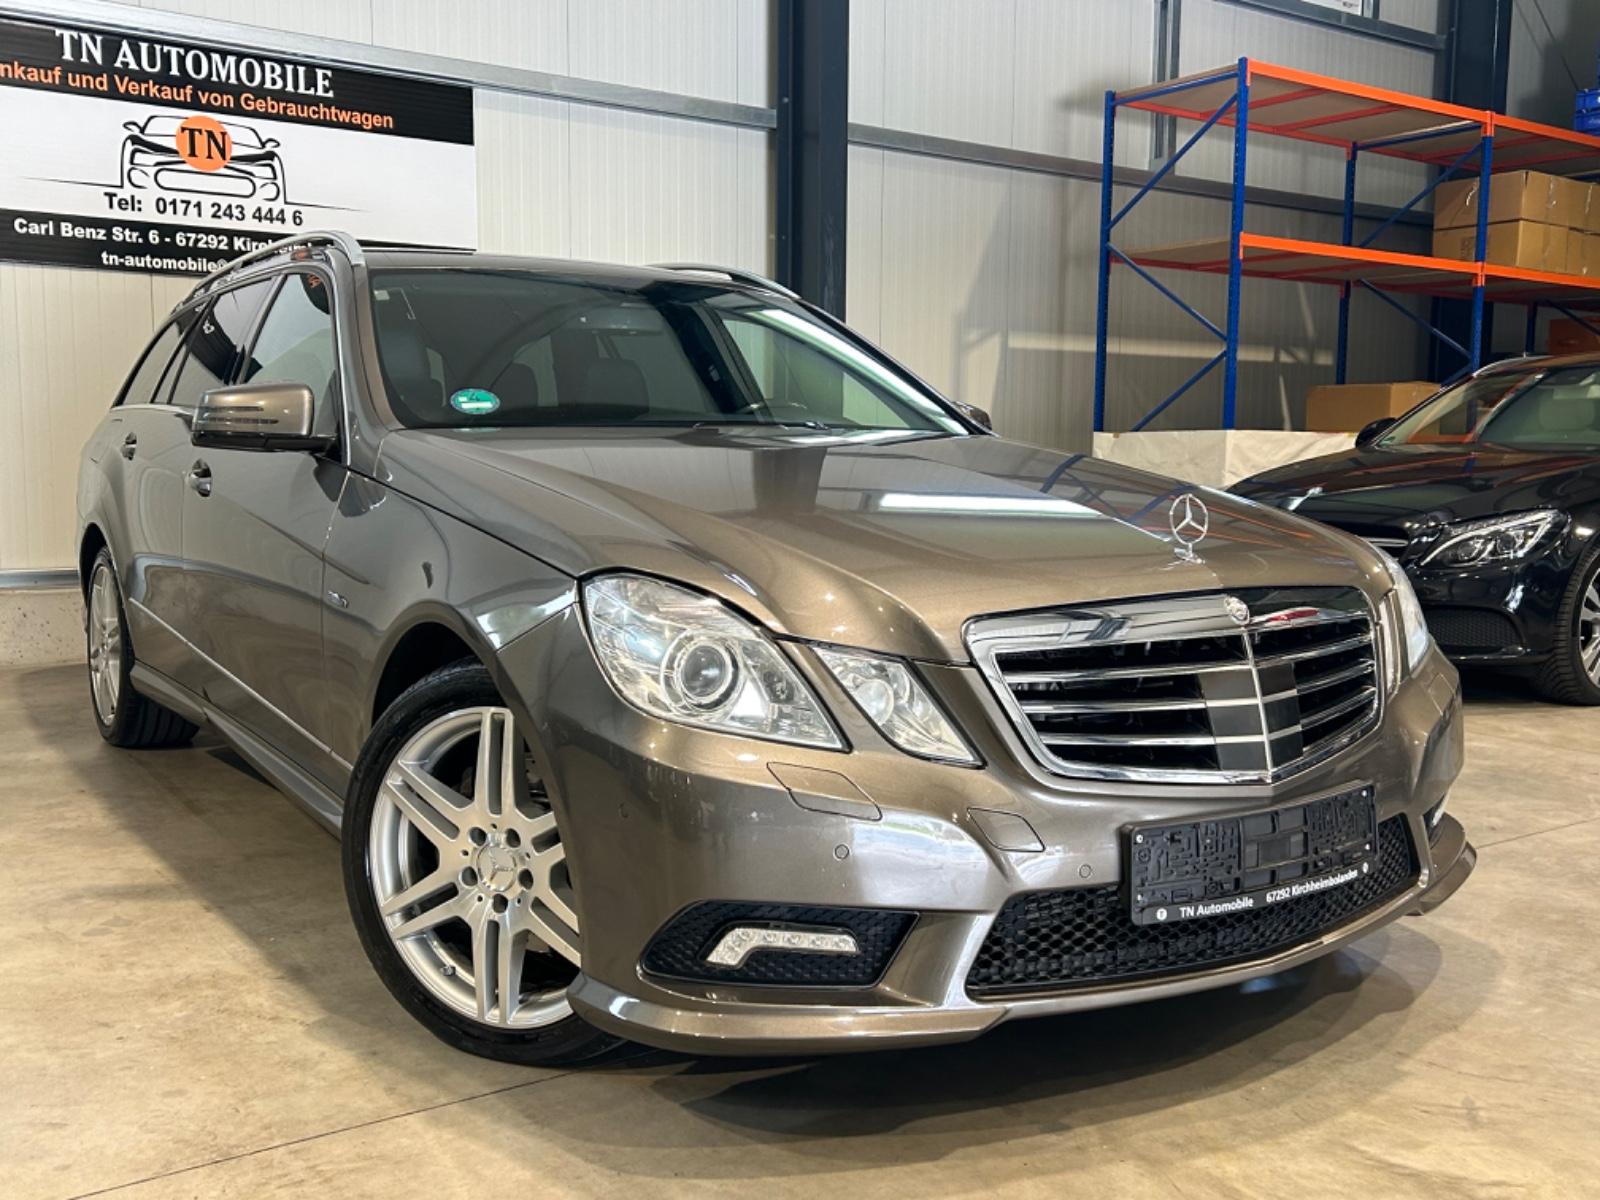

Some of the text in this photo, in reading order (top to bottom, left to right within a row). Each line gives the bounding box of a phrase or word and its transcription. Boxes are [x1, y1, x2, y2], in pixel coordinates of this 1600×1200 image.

[55, 29, 334, 98] TN AUTOMOBILE
[0, 60, 393, 130] nkauf und Verkauf von Gebrauchtwagen
[180, 126, 227, 161] TN
[104, 192, 303, 227] Tel: 0171 243 444 6
[13, 217, 54, 236] Carl
[60, 221, 107, 241] Benz
[112, 226, 143, 244] Str.
[148, 229, 160, 245] 6
[175, 231, 229, 250] 67292
[1179, 905, 1195, 918] TN
[1196, 897, 1254, 916] Automobile
[1266, 886, 1291, 903] 67292
